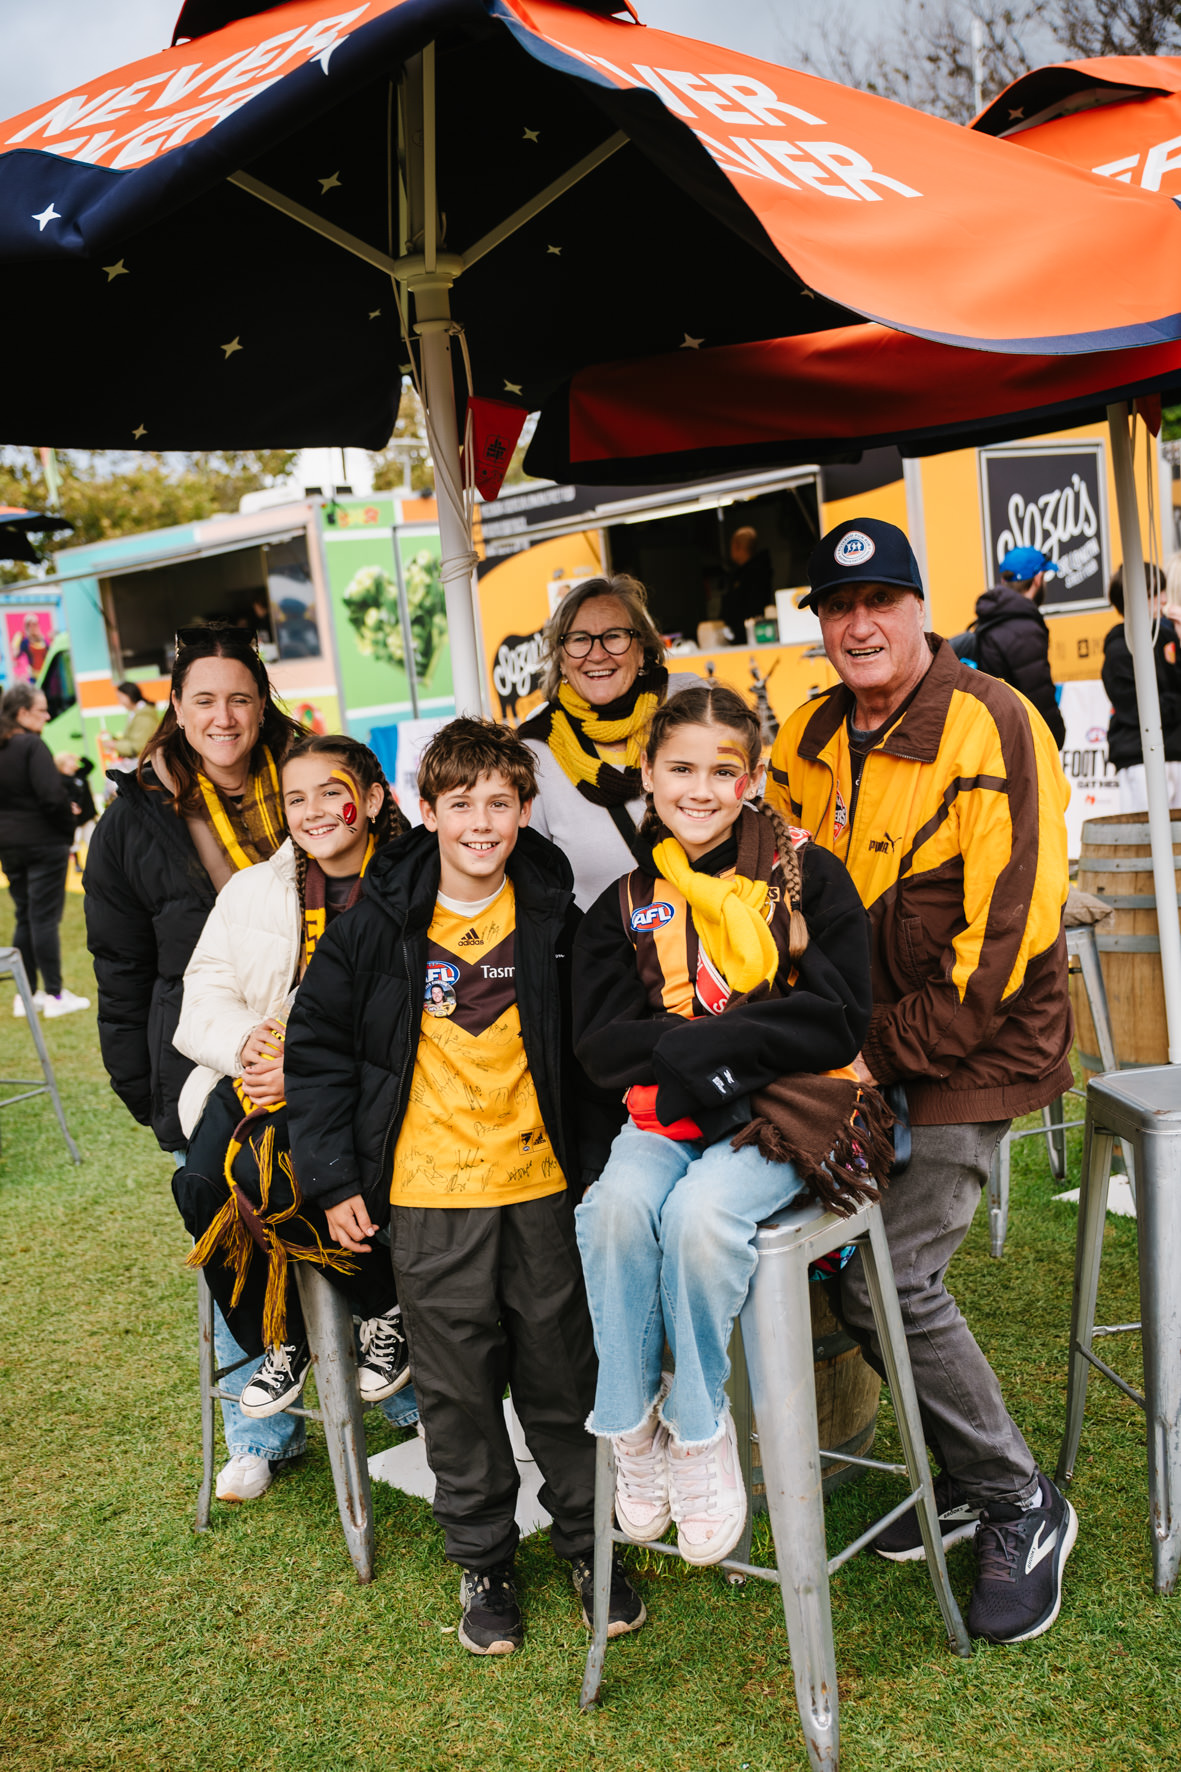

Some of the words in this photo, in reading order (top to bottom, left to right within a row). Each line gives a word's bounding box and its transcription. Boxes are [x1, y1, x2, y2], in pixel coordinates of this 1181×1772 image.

[4, 2, 371, 145] NEVER
[688, 128, 924, 201] VER
[869, 840, 889, 854] PUMA
[632, 906, 673, 929] AFL
[458, 938, 485, 947] adidas
[480, 965, 515, 979] Tasm
